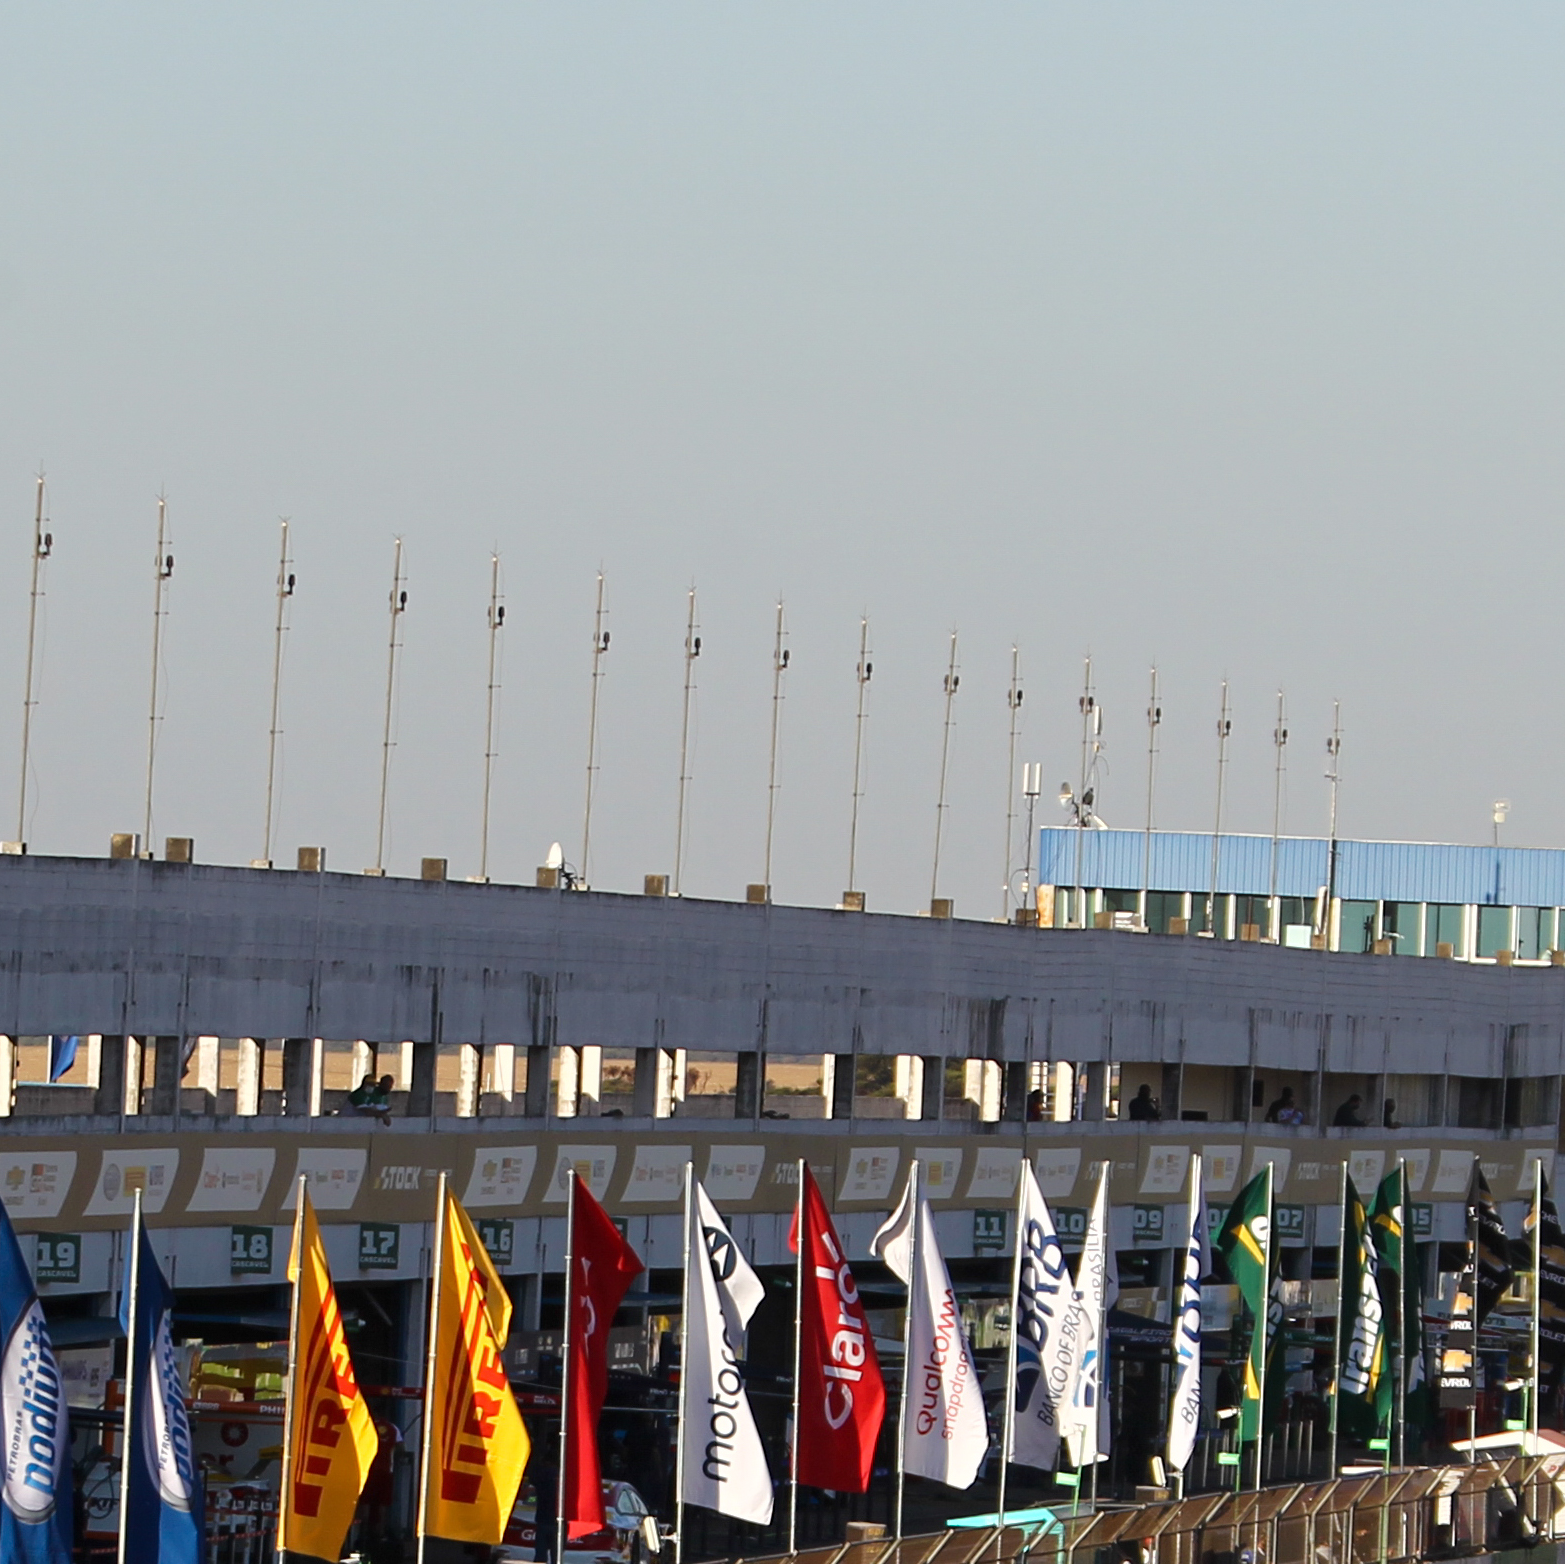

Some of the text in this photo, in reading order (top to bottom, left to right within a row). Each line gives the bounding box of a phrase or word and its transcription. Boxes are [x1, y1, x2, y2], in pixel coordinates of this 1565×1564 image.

[374, 1166, 422, 1190] STOCK
[770, 1162, 798, 1184] STOC
[975, 1216, 1002, 1236] 11
[1058, 1214, 1085, 1234] 10
[1135, 1208, 1164, 1228] 09
[1277, 1210, 1303, 1228] 07
[231, 1232, 269, 1259] 18
[361, 1230, 396, 1257] 17
[486, 1227, 511, 1251] 16
[37, 1241, 76, 1269] 19
[817, 1232, 866, 1431] Claro
[1037, 1366, 1069, 1428] BANCO
[6, 1409, 25, 1483] PETROBRAS
